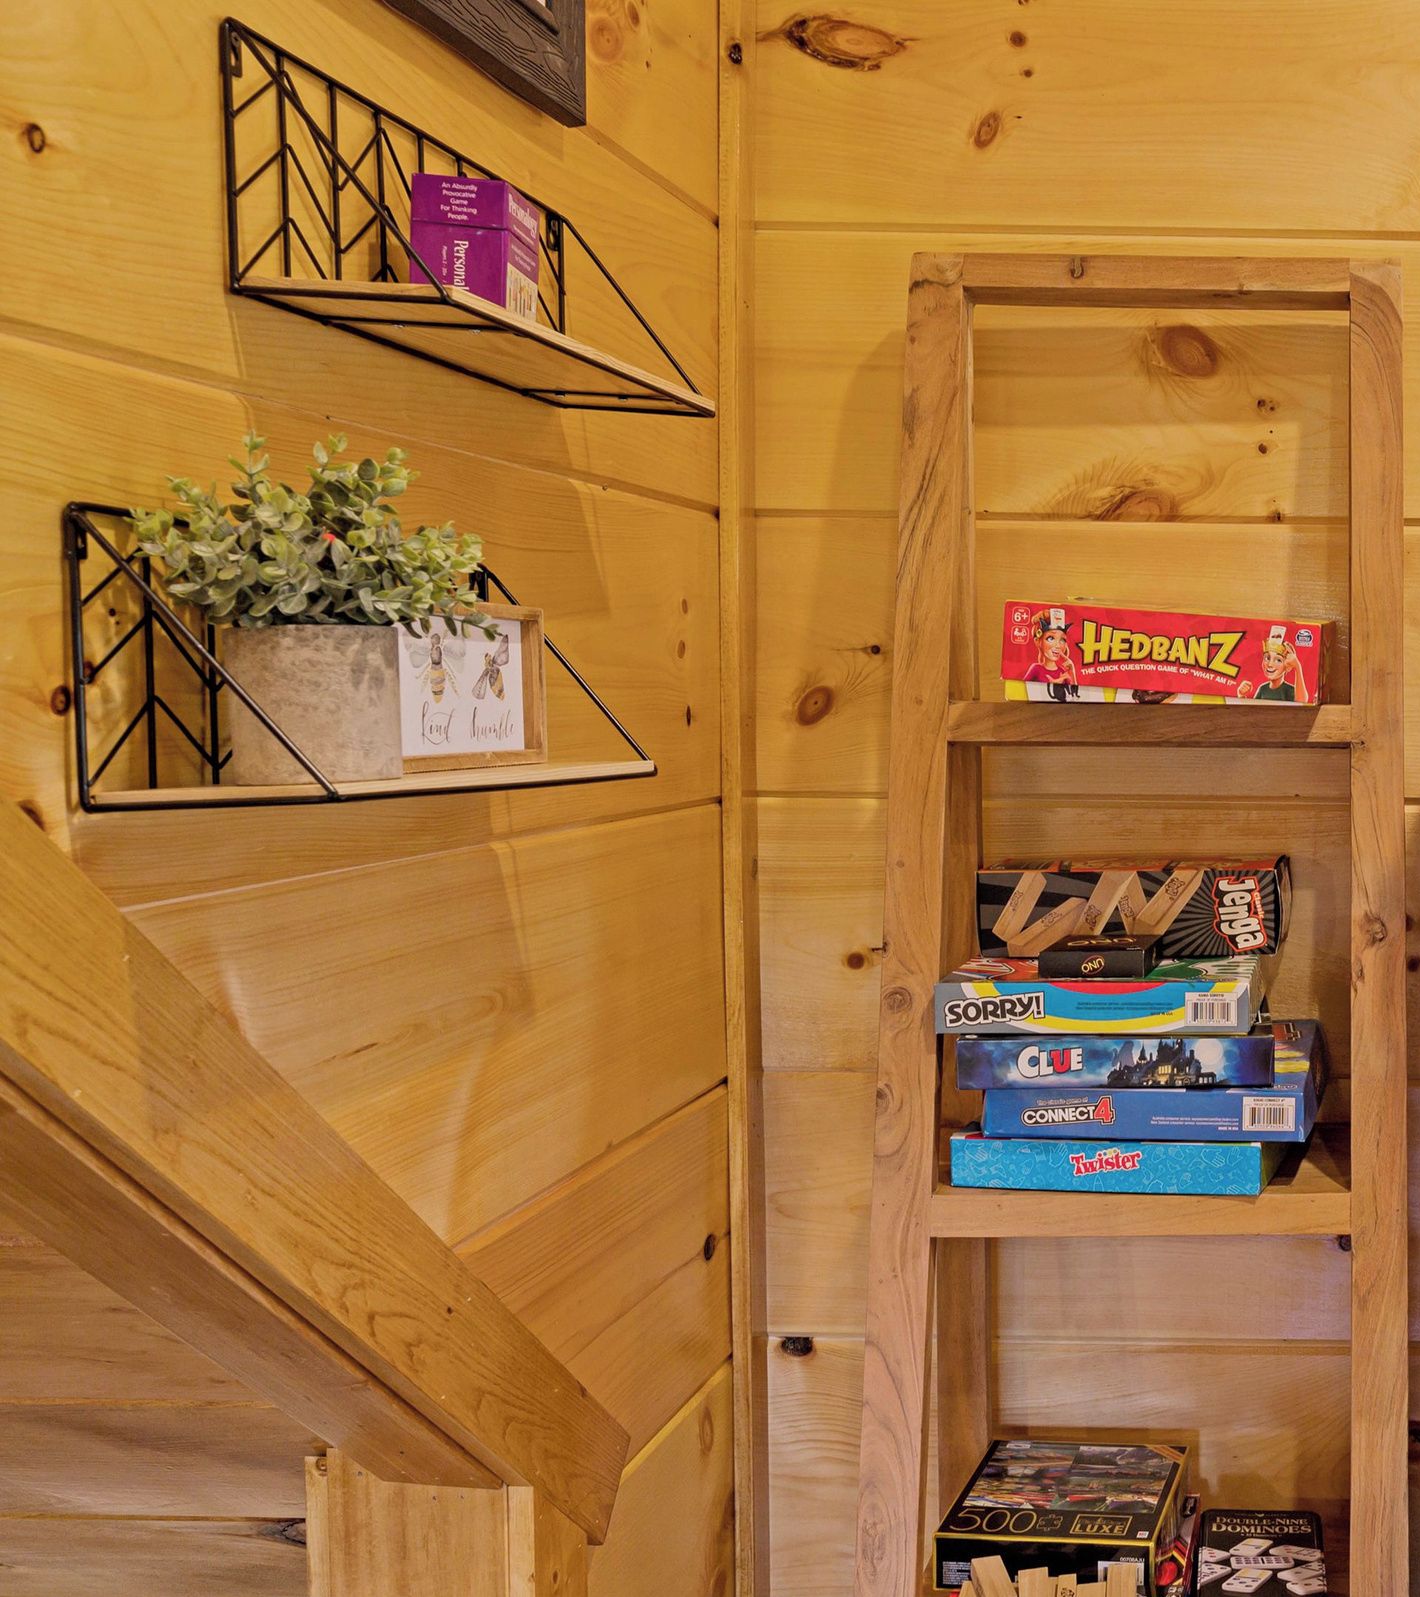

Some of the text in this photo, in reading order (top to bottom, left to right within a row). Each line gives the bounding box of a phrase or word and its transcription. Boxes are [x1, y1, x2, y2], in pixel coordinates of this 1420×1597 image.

[443, 190, 476, 198] Provocative
[452, 183, 477, 192] Absurdly
[452, 205, 477, 214] Thinking
[1014, 612, 1028, 622] 6+
[1077, 620, 1245, 678] HEDBANZ
[1081, 668, 1095, 676] THE
[1097, 664, 1118, 673] QUICK
[1120, 663, 1156, 671] QUESTION
[1158, 665, 1177, 673] GAME
[1179, 667, 1189, 675] OF
[1215, 676, 1227, 684] AM
[470, 706, 514, 742] humble
[1218, 879, 1265, 949] Jenga
[1081, 955, 1105, 974] UNO
[946, 994, 1043, 1025] SORRY!
[1017, 1045, 1083, 1079] CLUE
[1070, 1150, 1142, 1176] Twister
[949, 1508, 1037, 1533] 500
[1075, 1524, 1125, 1533] LUXE
[1211, 1523, 1312, 1534] DOMINOES
[1216, 1516, 1308, 1525] DOUBLE-NINE
